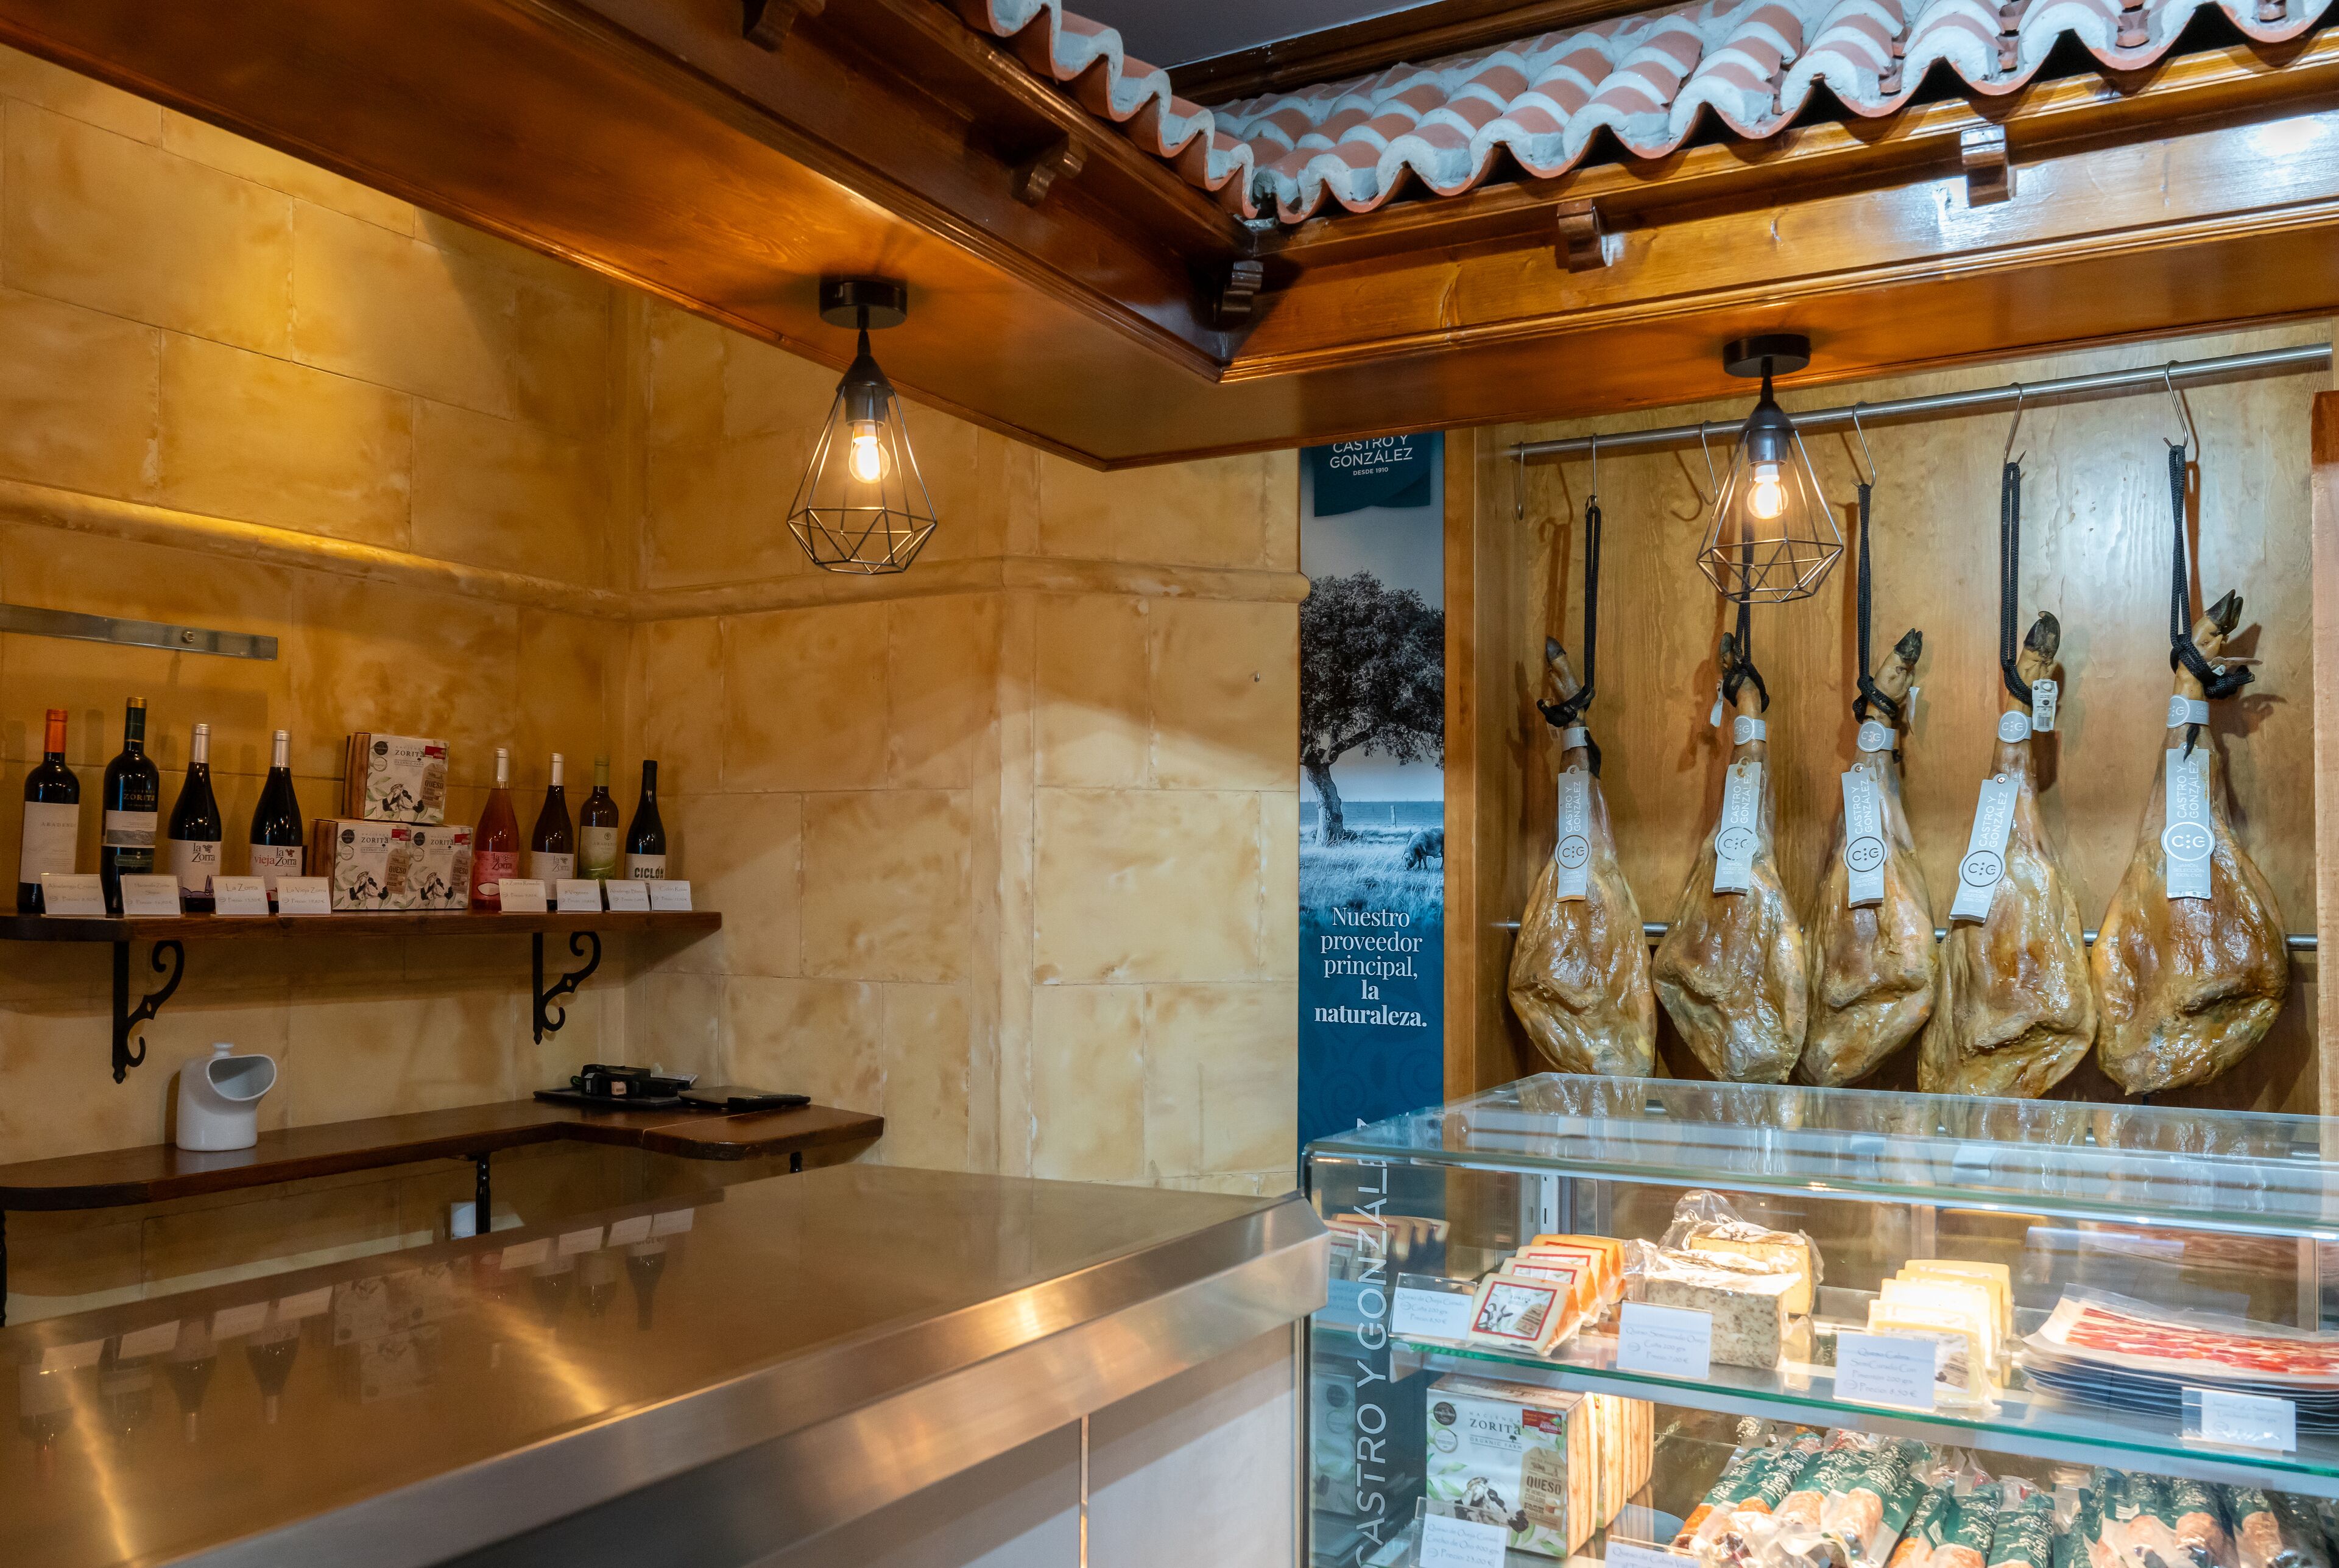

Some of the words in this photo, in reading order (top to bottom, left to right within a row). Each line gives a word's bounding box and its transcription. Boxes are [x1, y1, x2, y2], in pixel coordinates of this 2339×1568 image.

[1333, 437, 1394, 453] CASTRO
[1400, 435, 1408, 445] Y
[1330, 447, 1413, 468] GONZÁLEZ
[425, 779, 444, 789] QUESO
[2177, 775, 2187, 818] CASTRO
[1852, 795, 1863, 834] CASTRO
[1978, 806, 1994, 846] CASTRO
[193, 843, 201, 852] la
[276, 847, 284, 856] la
[191, 852, 215, 862] Zorra
[254, 855, 275, 867] vieja
[275, 856, 297, 867] Zorra
[389, 865, 406, 874] QUESO
[492, 861, 512, 870] Zorra
[634, 866, 665, 879] CICLÓN
[225, 883, 236, 892] La
[237, 883, 258, 892] Zorra
[1332, 907, 1410, 927] Nuestro
[1321, 932, 1423, 954] proveedor
[1324, 955, 1418, 980] principal,
[1361, 979, 1380, 1000] la
[1314, 1005, 1427, 1027] naturaleza.
[1397, 1292, 1417, 1301] Queso
[1443, 1298, 1465, 1307] Curado
[1626, 1326, 1648, 1335] Queso
[1356, 1360, 1386, 1388] Y
[1469, 1411, 1521, 1424] HACIENDA
[1469, 1436, 1501, 1446] ORGANIC
[1526, 1475, 1561, 1496] QUESO
[1428, 1524, 1448, 1532] Queso
[1459, 1541, 1474, 1549] Oro
